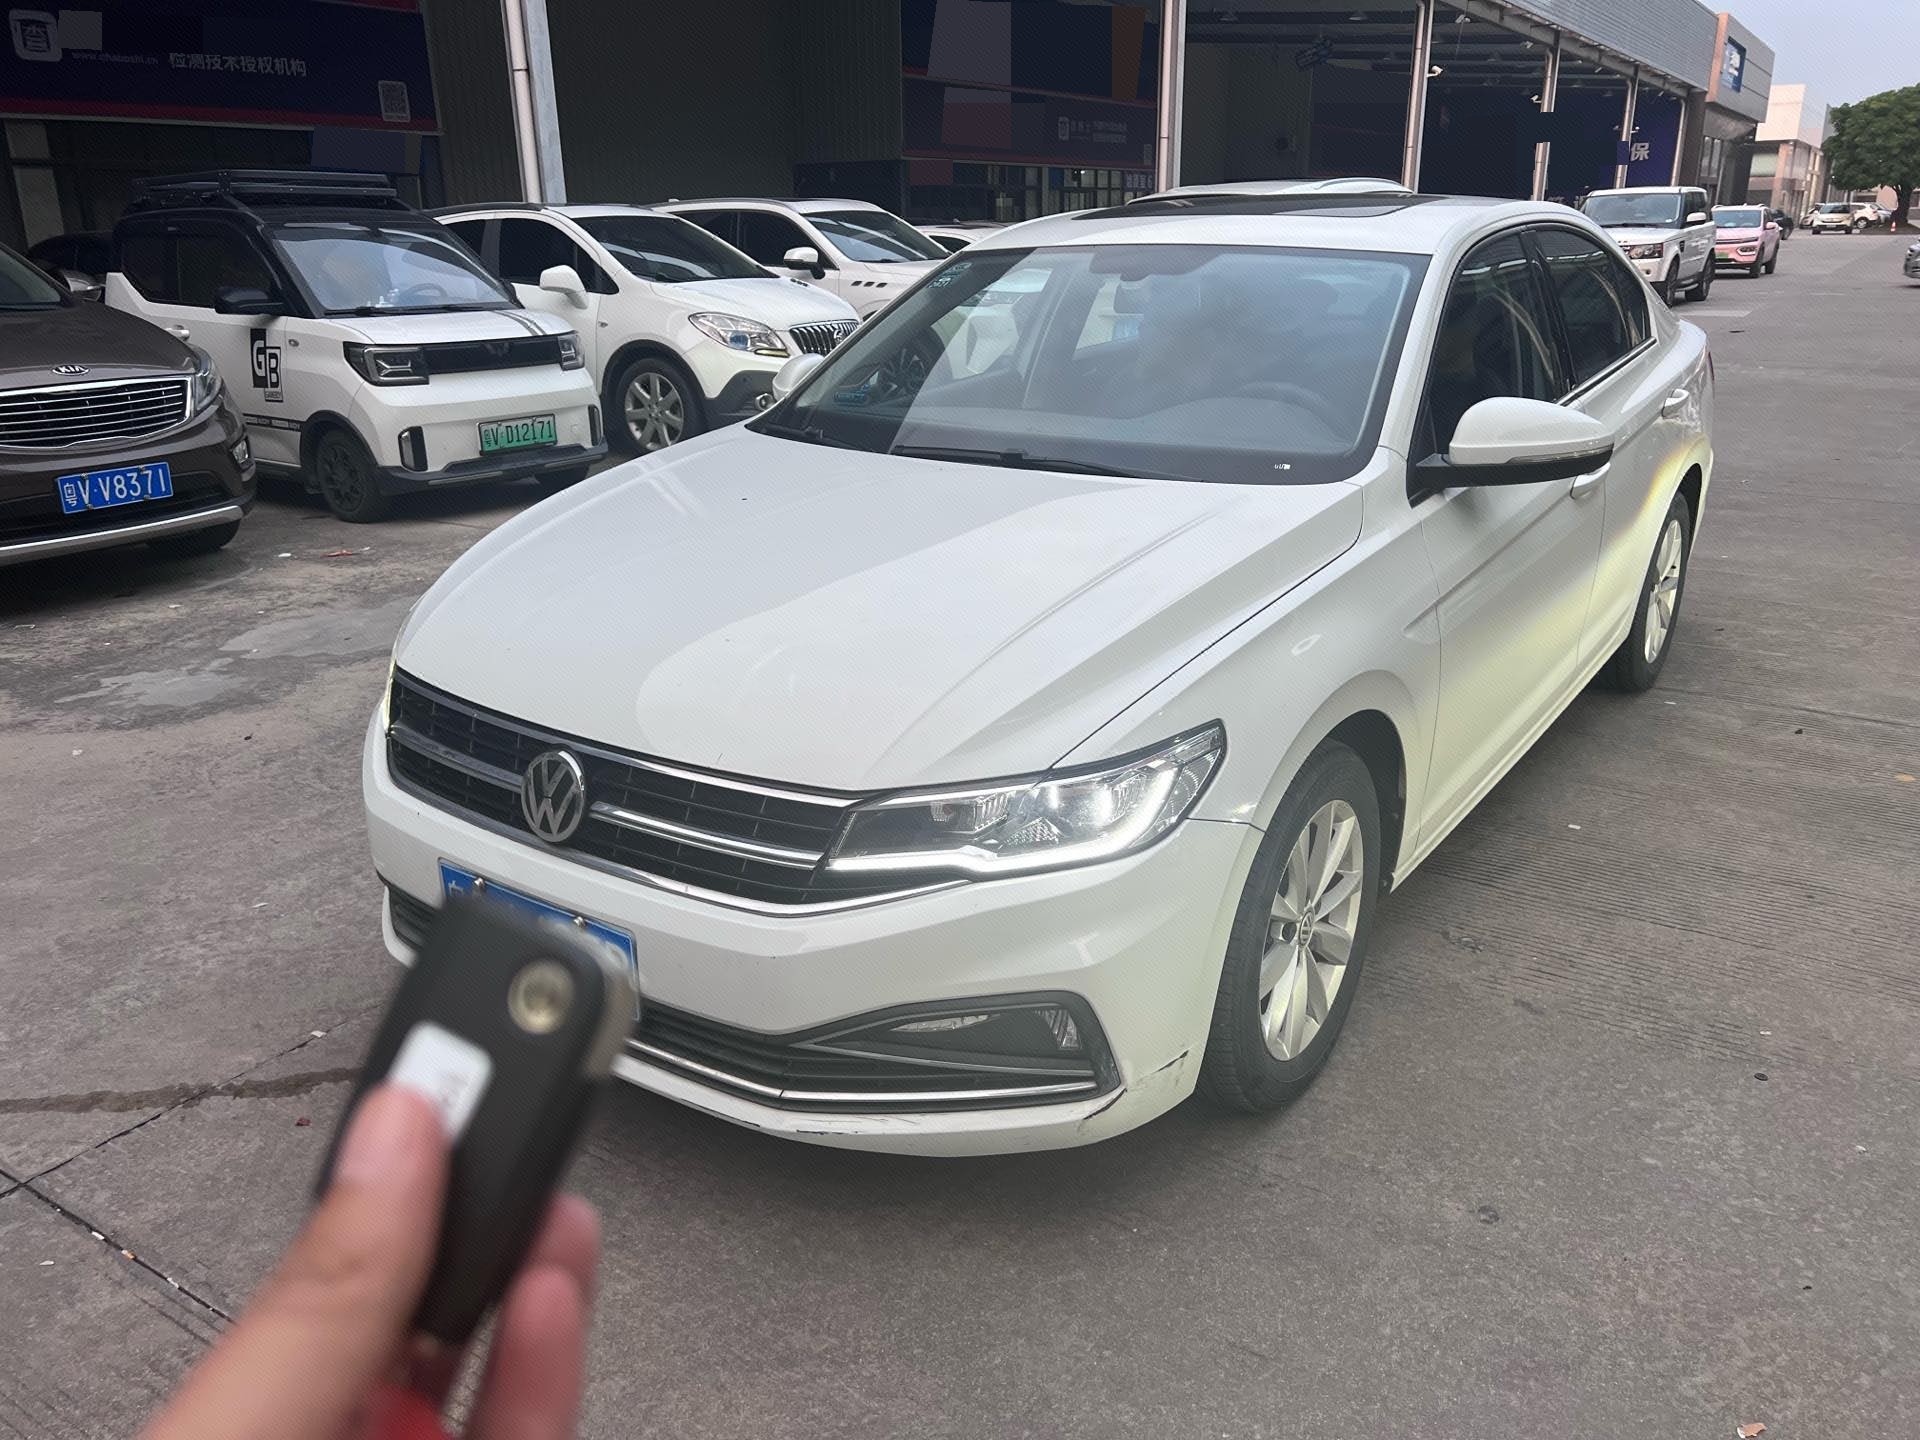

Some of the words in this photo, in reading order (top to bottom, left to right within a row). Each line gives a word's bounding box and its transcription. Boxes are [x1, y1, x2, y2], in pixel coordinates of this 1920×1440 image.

[168, 52, 307, 77] 检测技术授权机构
